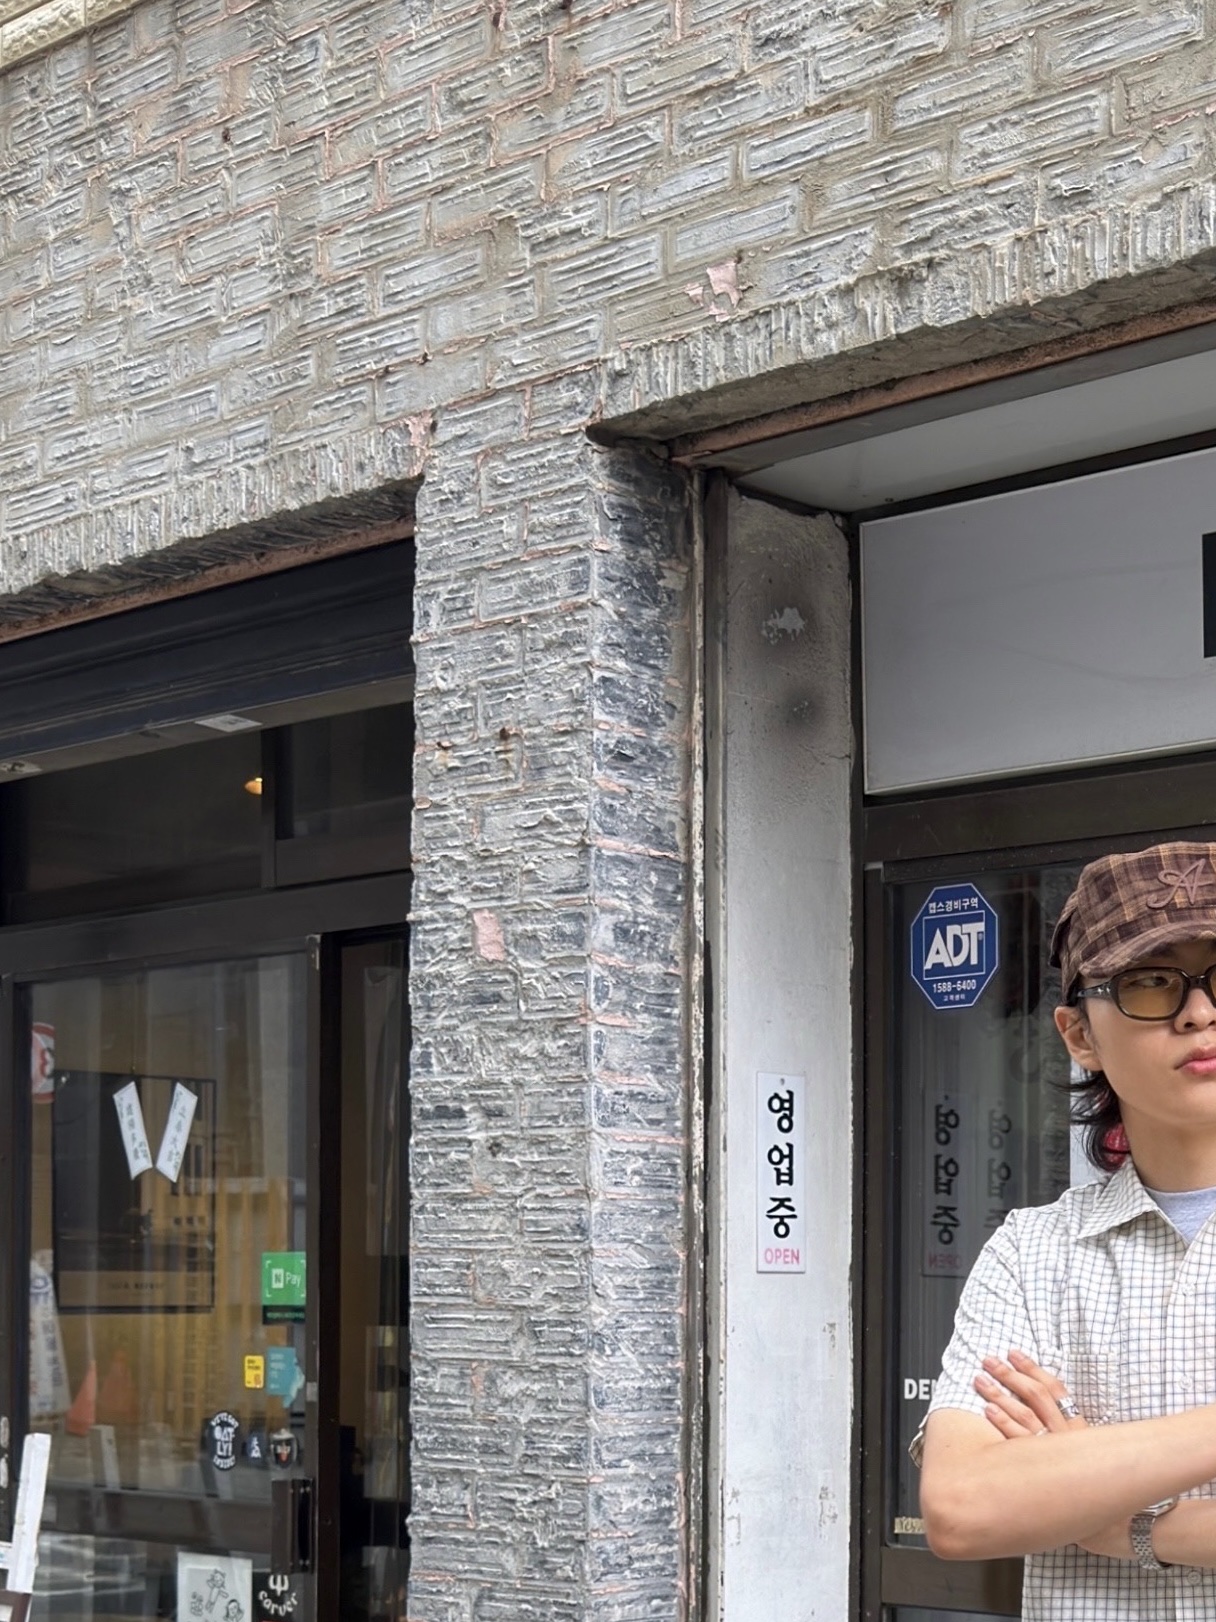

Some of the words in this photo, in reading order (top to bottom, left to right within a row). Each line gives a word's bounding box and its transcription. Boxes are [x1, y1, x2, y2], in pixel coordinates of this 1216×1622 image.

[928, 897, 979, 914] 캡스경비구역
[924, 921, 984, 970] ADT
[933, 979, 977, 994] 1588-6400
[766, 1090, 797, 1239] 영업중
[764, 1248, 800, 1264] OPEN
[285, 1272, 302, 1288] Pay
